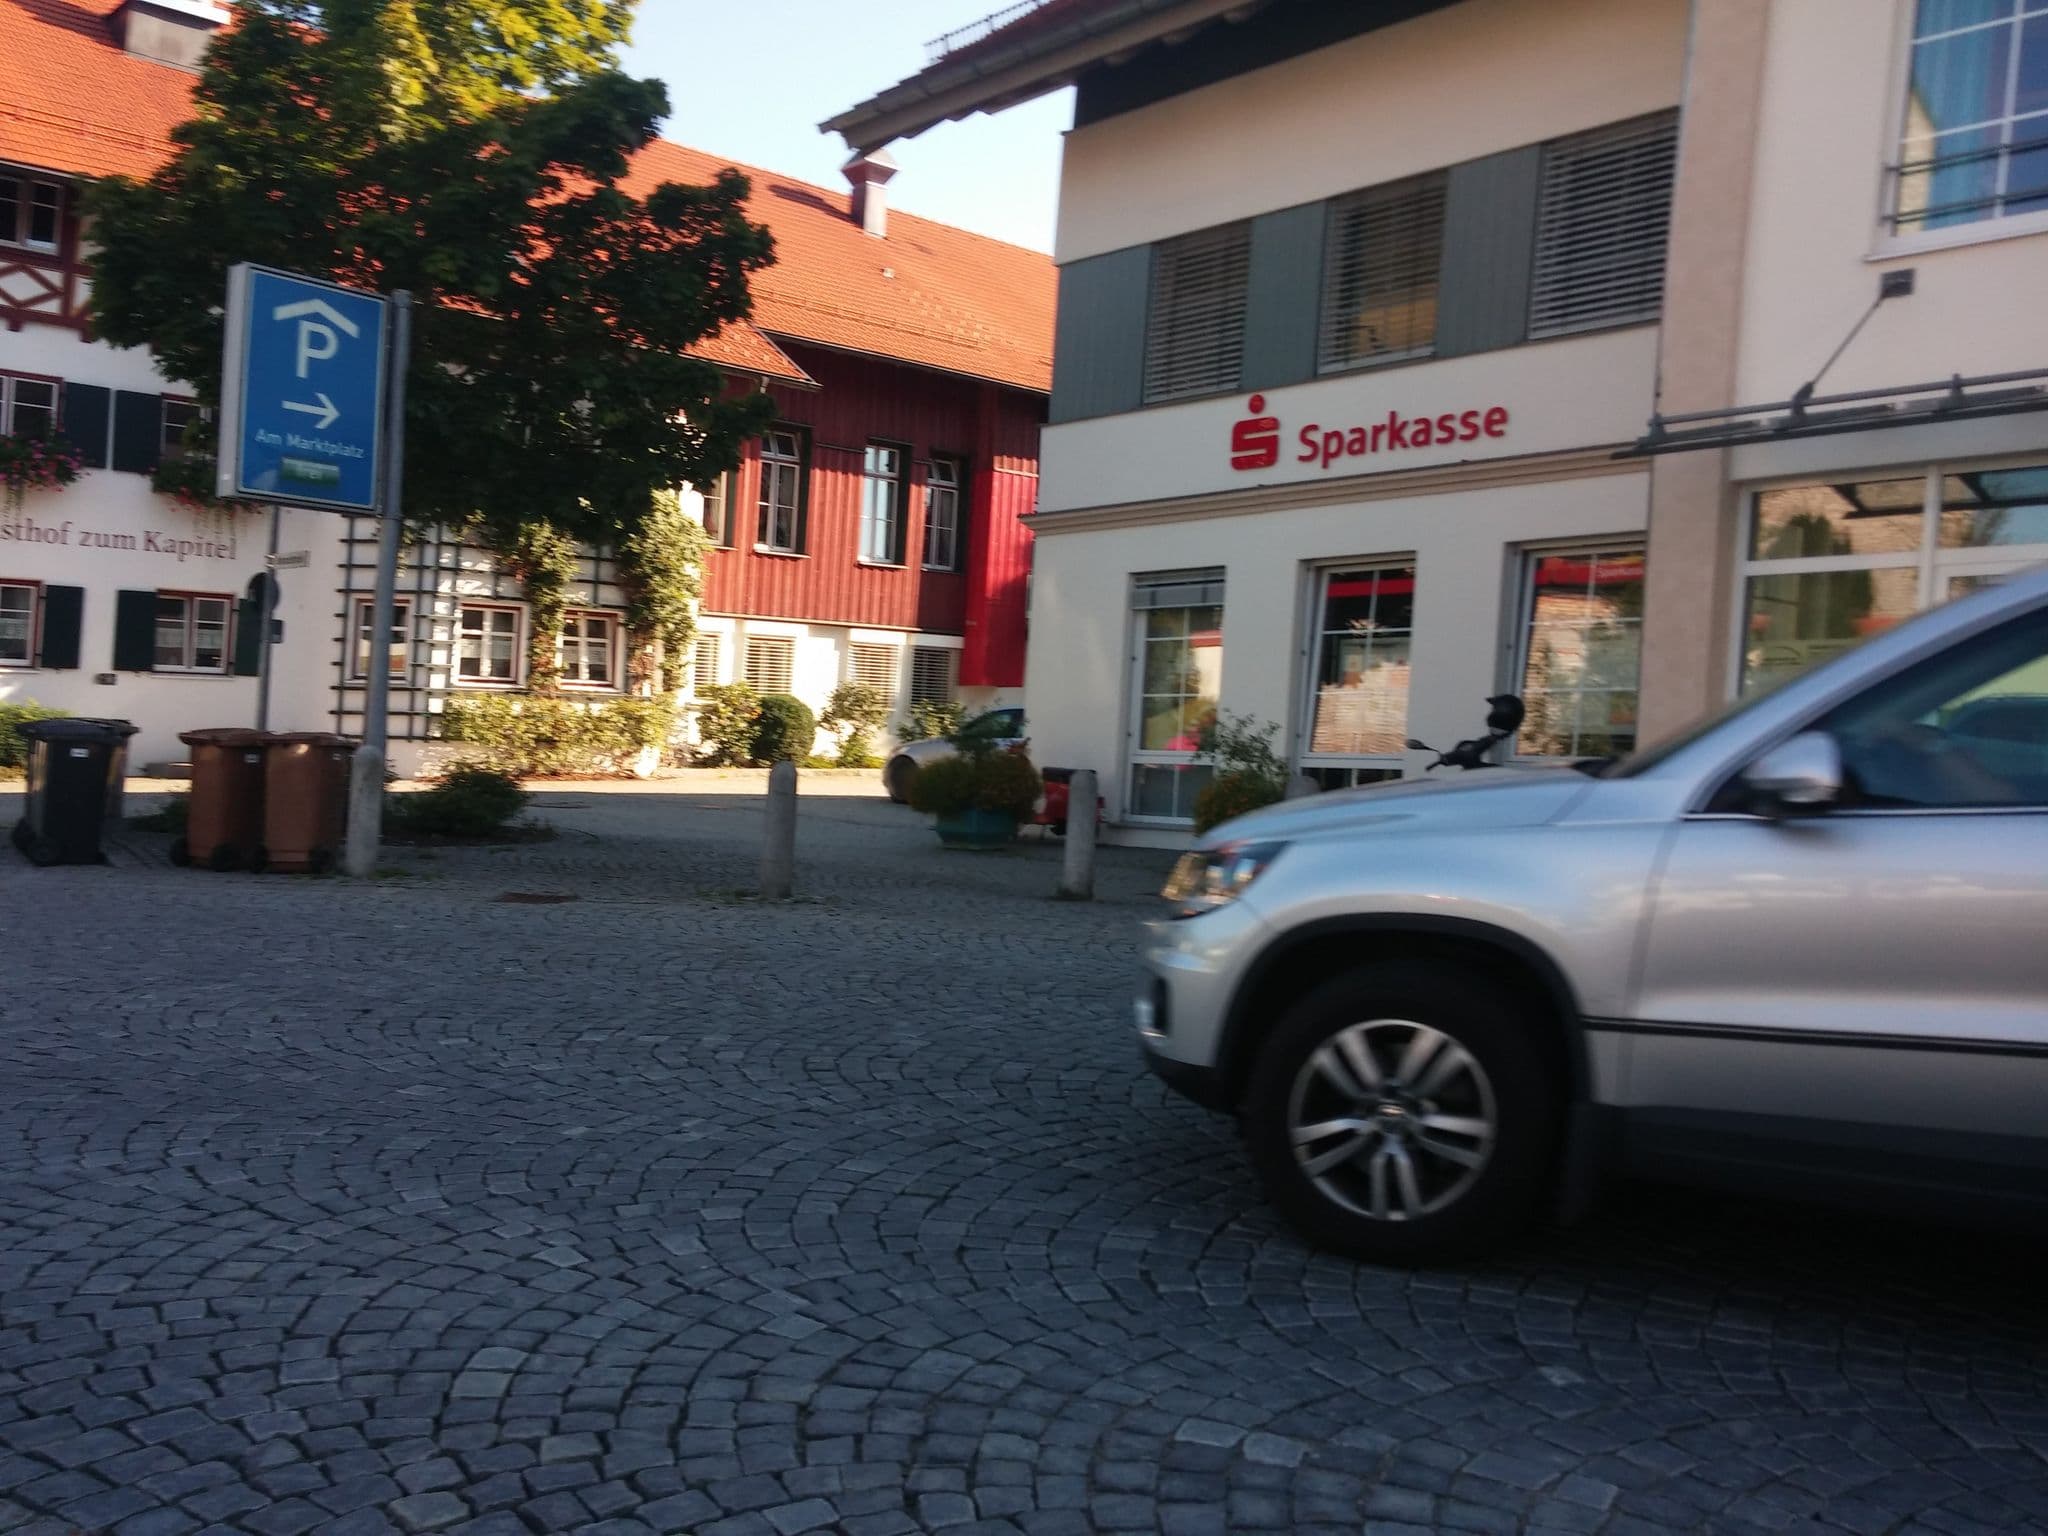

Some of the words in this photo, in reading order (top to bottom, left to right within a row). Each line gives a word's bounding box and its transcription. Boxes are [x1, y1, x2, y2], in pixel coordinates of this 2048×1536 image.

[296, 319, 339, 379] P
[254, 428, 283, 446] Am
[285, 432, 365, 459] Marktplatz
[1297, 406, 1510, 469] Sparkasse
[78, 530, 137, 551] zum
[143, 530, 238, 563] Kapitel
